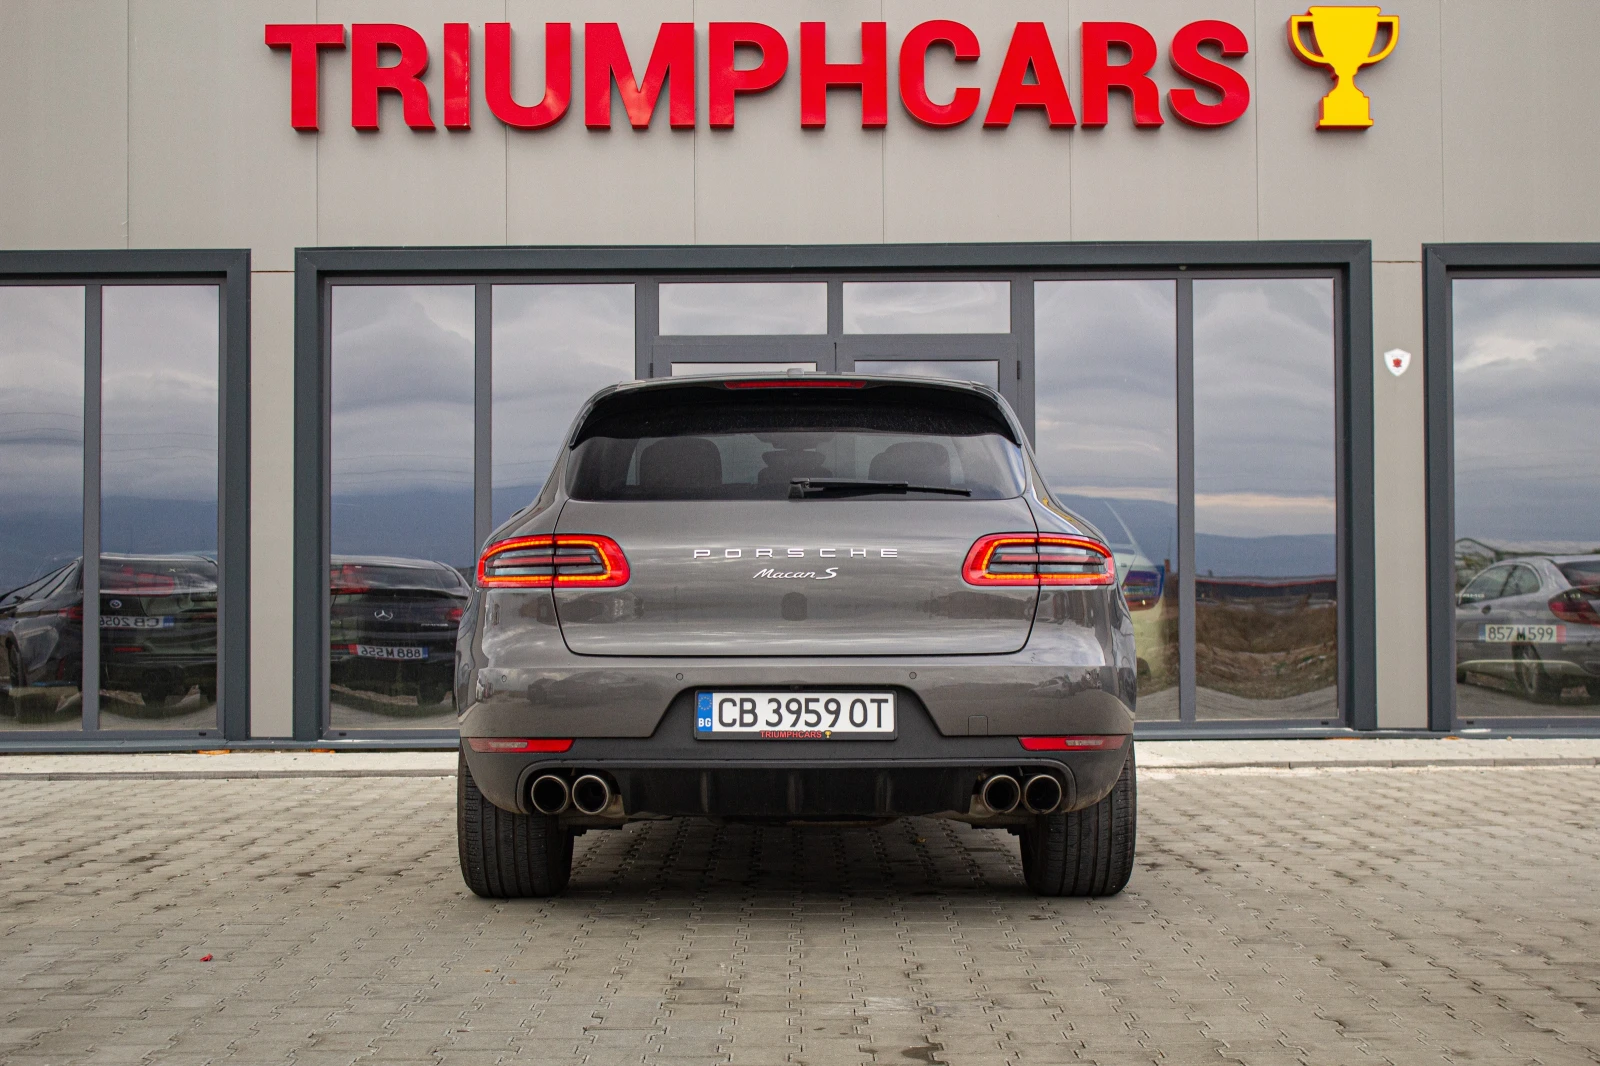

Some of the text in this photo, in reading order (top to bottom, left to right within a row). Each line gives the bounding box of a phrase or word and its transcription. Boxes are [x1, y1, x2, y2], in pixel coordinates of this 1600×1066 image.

[264, 19, 1250, 131] TRIUMPHCARS
[694, 548, 898, 559] PORSCHE
[753, 567, 839, 580] Macan S
[1488, 626, 1514, 641] 857
[1528, 626, 1554, 641] 599
[718, 697, 758, 728] CB
[765, 697, 842, 728] 3959
[698, 717, 712, 728] BG
[760, 730, 822, 739] TRIUMPHCARS
